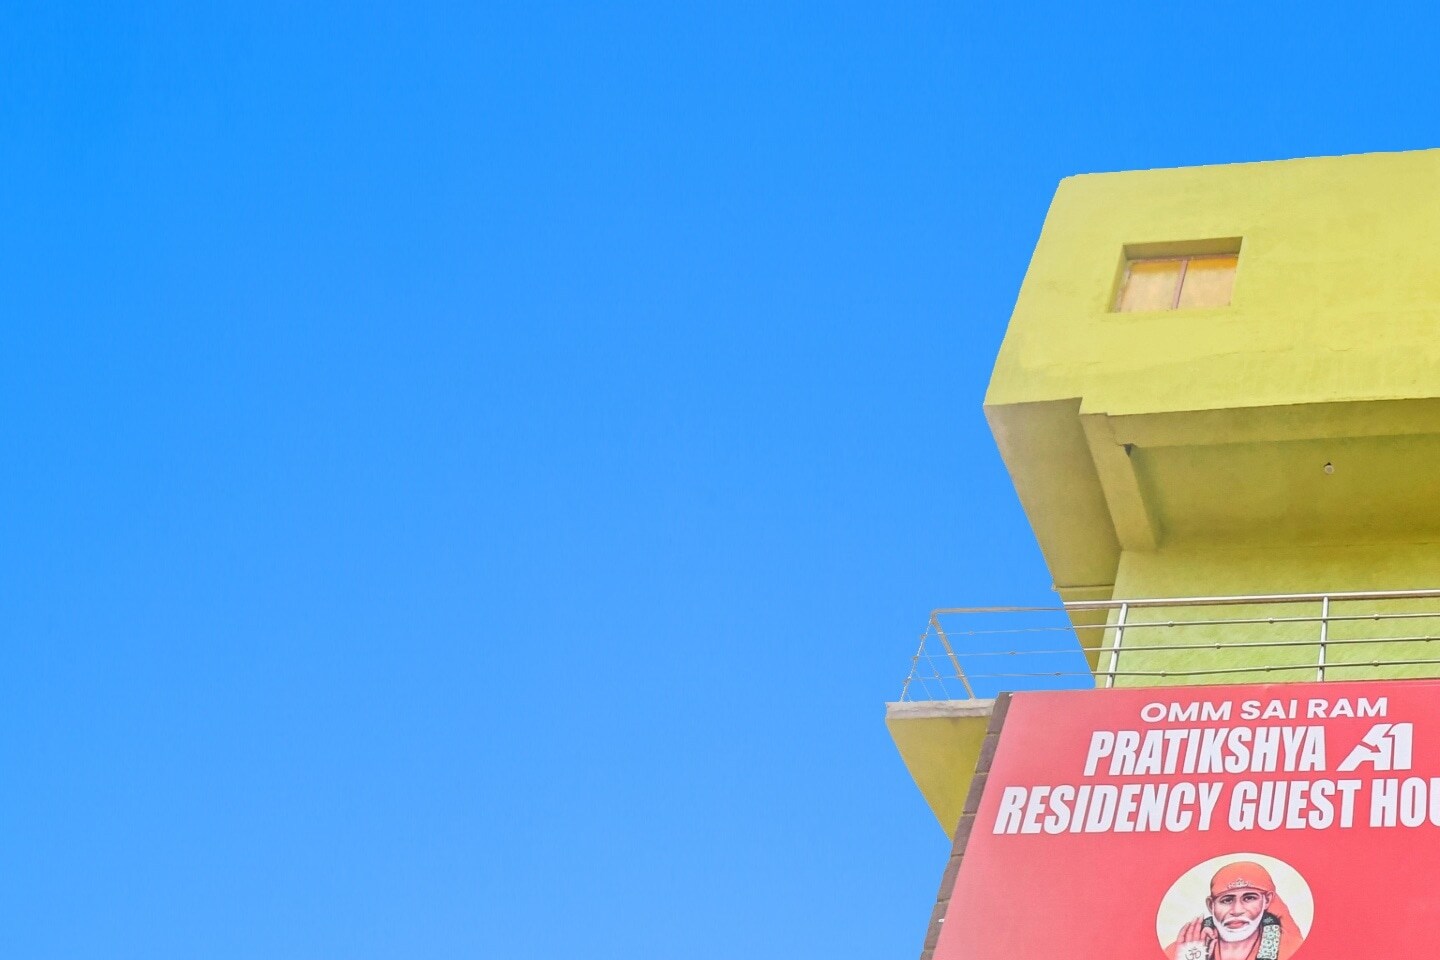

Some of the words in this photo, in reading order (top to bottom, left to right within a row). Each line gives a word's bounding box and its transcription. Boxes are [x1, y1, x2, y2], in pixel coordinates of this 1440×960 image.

[1140, 701, 1233, 723] OMM
[1240, 699, 1298, 720] SAI
[1306, 697, 1388, 719] RAM
[1083, 725, 1326, 776] PRATIKSHYA
[1336, 722, 1413, 772] A1
[992, 782, 1224, 835] RESIDENCY
[1228, 779, 1361, 831] GUEST
